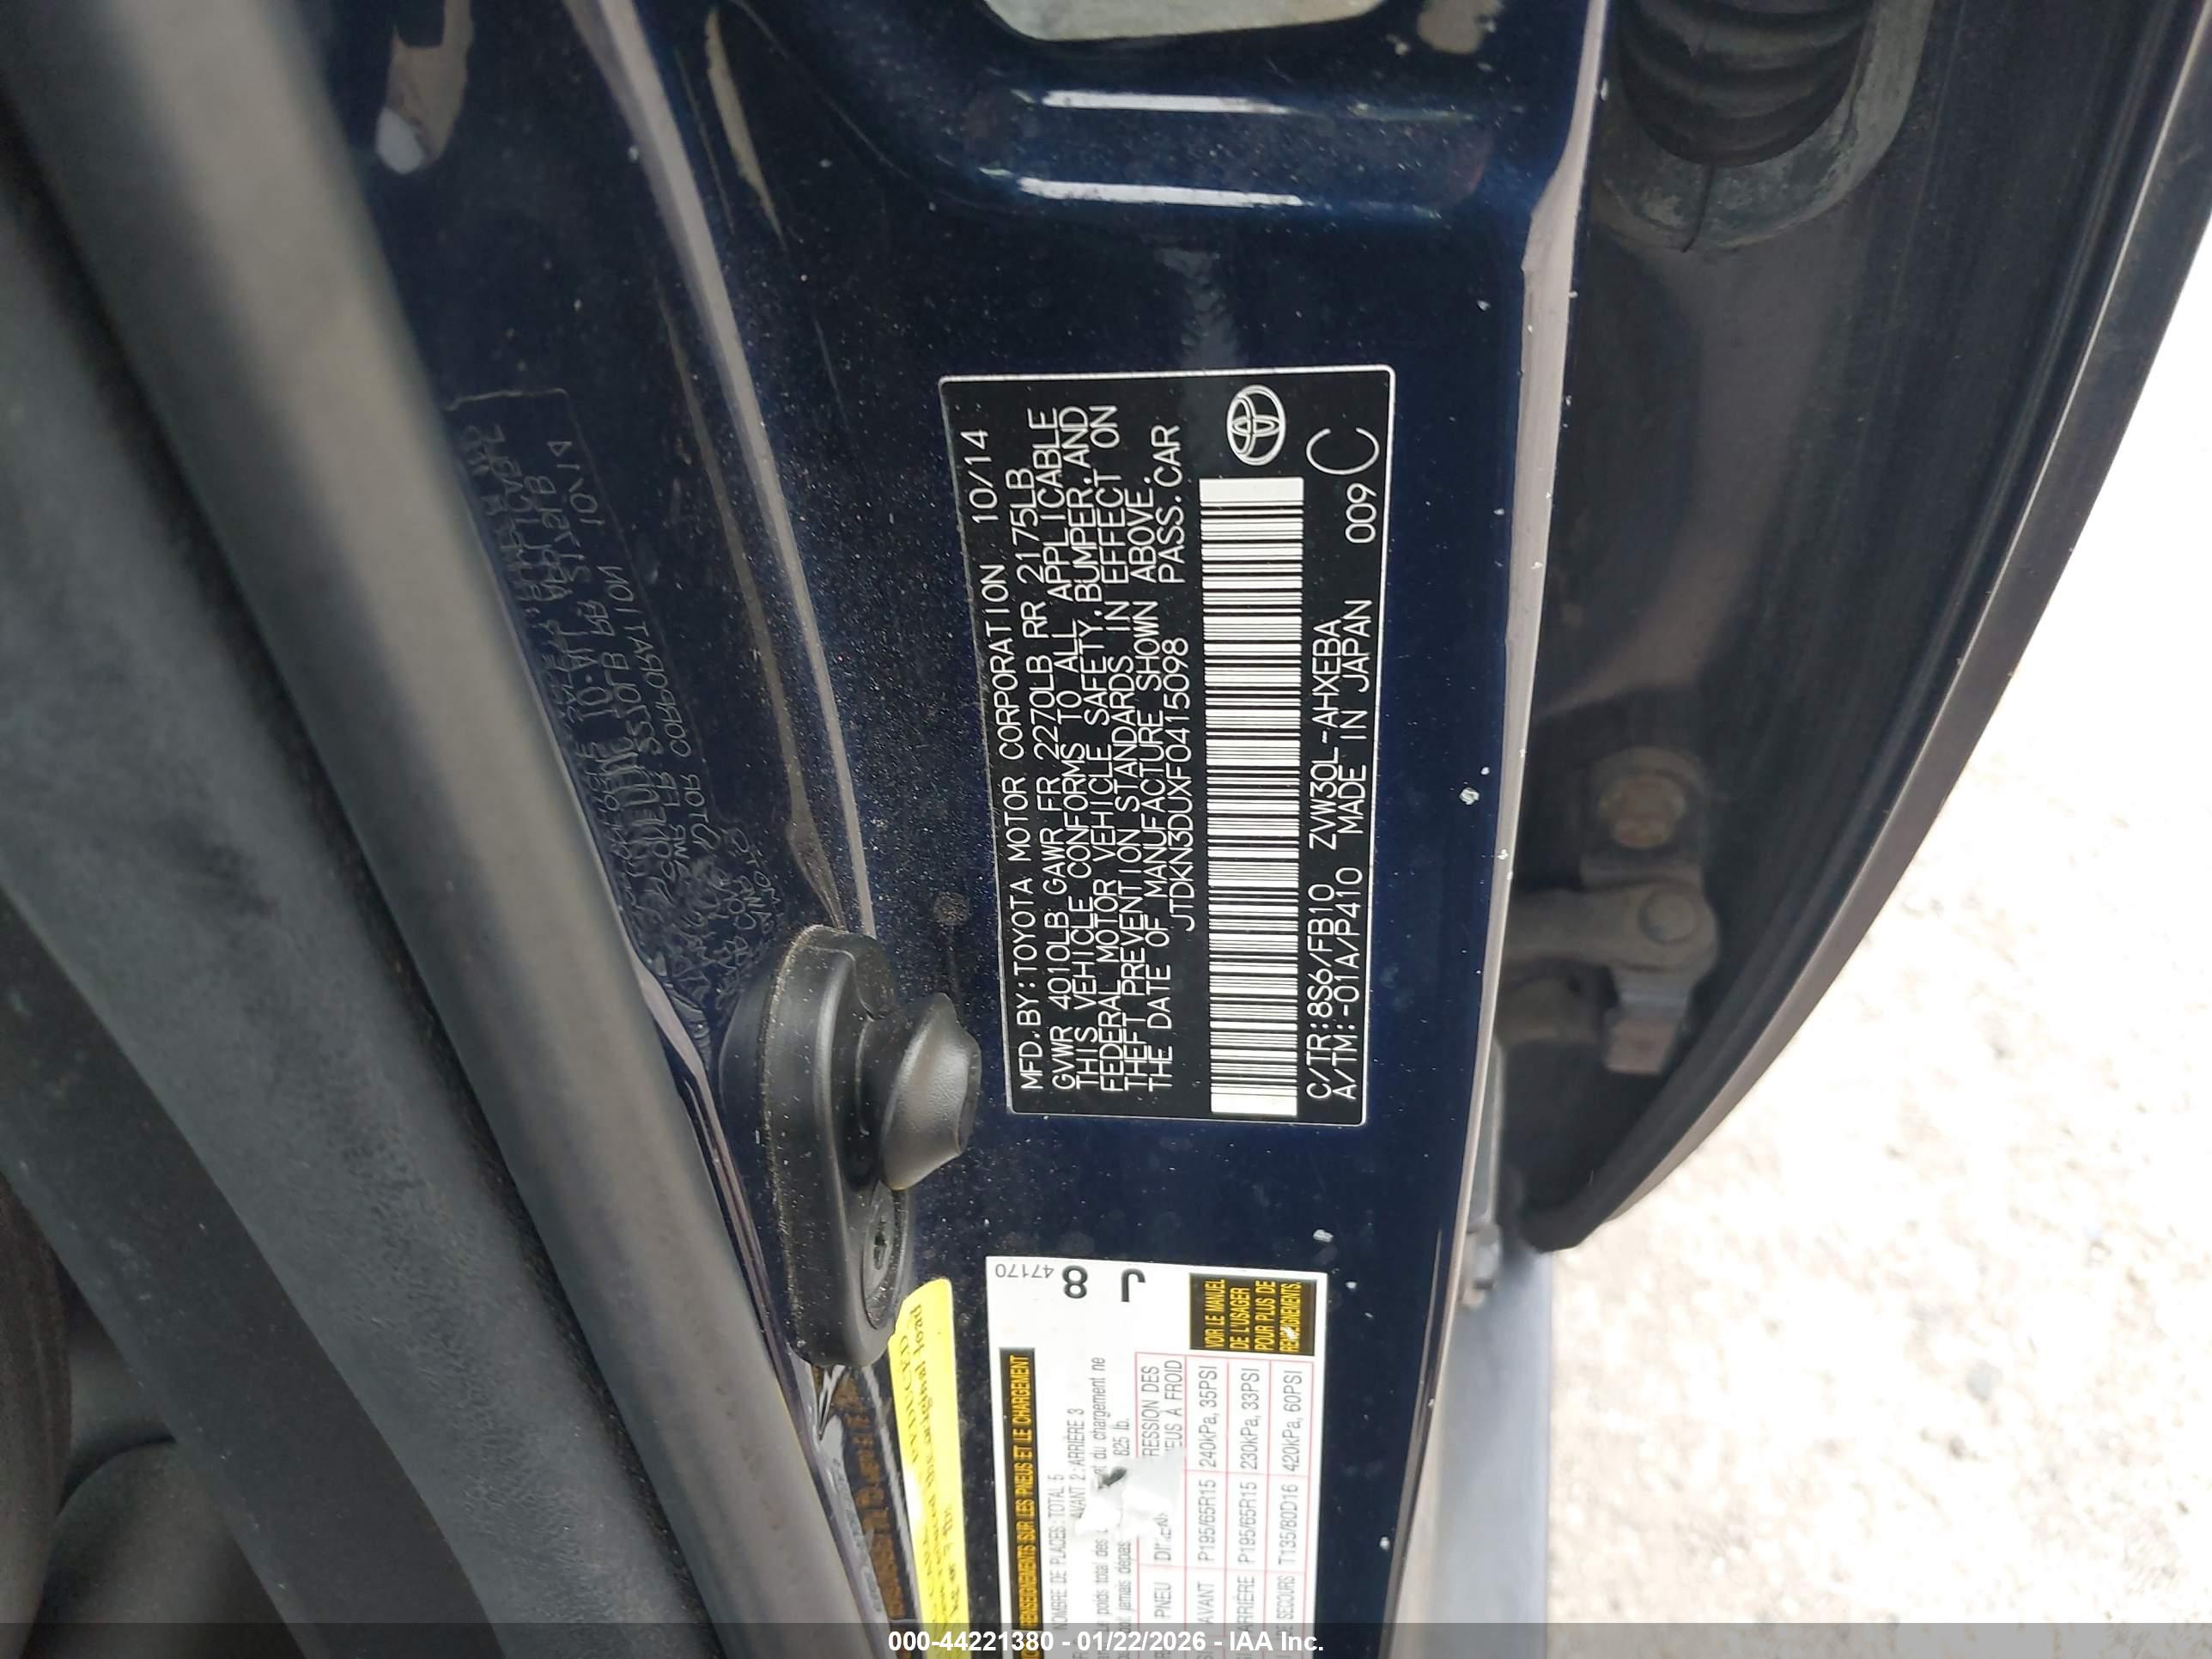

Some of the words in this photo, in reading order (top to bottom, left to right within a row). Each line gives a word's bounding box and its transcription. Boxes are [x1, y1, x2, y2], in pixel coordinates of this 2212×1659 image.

[1089, 405, 1121, 450] ON
[1305, 427, 1380, 476] C
[960, 428, 999, 523] 10/14
[1005, 467, 1044, 585] 2175LB
[1027, 408, 1074, 601] APPLICABLE
[1093, 470, 1130, 585] EFFECT
[1124, 476, 1157, 585] ABOVE.
[1345, 483, 1377, 544] 009
[1020, 600, 1050, 638] RR
[1105, 600, 1130, 632] IN
[979, 564, 1024, 760] CORPORATION
[1051, 617, 1080, 673] ALL
[1133, 600, 1162, 692] SHOWN
[1341, 599, 1373, 693] JAPAN
[1026, 654, 1060, 760] 2270LB
[1054, 690, 1084, 726] TO
[1108, 654, 1140, 813] STANDARDS
[1340, 710, 1368, 739] IN
[1309, 618, 1341, 851] ZVW30L-AHXEBA
[1036, 775, 1061, 812] FR
[1060, 743, 1092, 879] CONFORMS
[1086, 744, 1115, 863] VEHICLE
[1136, 709, 1168, 899] MANUFACTURE
[1161, 636, 1195, 933] JTDKN3DUXF0415098
[1337, 763, 1366, 835] MADE
[1002, 775, 1032, 861] MOTOR
[1039, 827, 1067, 896] GAWR
[1093, 878, 1120, 963] MOTOR
[1116, 829, 1146, 996] PREVENTION
[1145, 913, 1169, 947] OF
[1043, 911, 1073, 1011] 4010LB
[1067, 896, 1097, 1010] VEHICLE
[1146, 963, 1172, 1030] DATE
[1306, 883, 1335, 1100] C/TR:8S6/FB10
[1332, 866, 1363, 1101] A/TM:-01A/P410
[1050, 1024, 1076, 1090] GVWR
[1075, 1025, 1100, 1091] THIS
[1097, 978, 1124, 1091] FEDERAL
[1122, 1012, 1147, 1091] THEFT
[1148, 1044, 1172, 1092] THE
[995, 1263, 1054, 1279] 47170
[1061, 1264, 1088, 1299] 8
[1120, 1267, 1146, 1303] J
[1204, 1279, 1226, 1312] MANUEL
[1255, 1279, 1277, 1294] DE
[909, 1304, 926, 1355] load
[1204, 1314, 1225, 1327] LE
[1229, 1287, 1251, 1333] L'USAGER
[1255, 1297, 1276, 1322] PLUS
[1090, 1356, 1106, 1371] ne
[1204, 1328, 1225, 1348] VOIR
[1229, 1336, 1250, 1351] DE
[1254, 1325, 1275, 1351] POUR
[1009, 1354, 1032, 1425] CHARGEMENT
[1140, 1365, 1160, 1393] DES
[1164, 1358, 1183, 1401] FROID
[1198, 1365, 1218, 1407] 35PSI
[1241, 1368, 1261, 1410] 33PSI
[1283, 1370, 1303, 1413] 60PSI
[1090, 1376, 1111, 1441] chargement
[1140, 1399, 1160, 1457] RESSION
[1012, 1428, 1033, 1443] LE
[1012, 1444, 1034, 1461] ET
[1090, 1444, 1107, 1460] du
[1113, 1431, 1130, 1456] 825
[1198, 1413, 1221, 1468] 240kPa,
[1240, 1415, 1262, 1470] 230kPa,
[1282, 1418, 1304, 1473] 420kPa,
[1013, 1462, 1035, 1495] PNEUS
[1015, 1498, 1036, 1518] LES
[1016, 1521, 1036, 1542] SUR
[1197, 1478, 1217, 1562] P195/65R15
[1237, 1480, 1258, 1564] P195/65R15
[1278, 1483, 1299, 1565] T135/80D16
[1092, 1538, 1109, 1557] des
[1093, 1563, 1109, 1583] total
[1049, 1569, 1068, 1584] DE
[1154, 1582, 1172, 1619] PNEU
[1197, 1580, 1216, 1626] AVANT
[1275, 1575, 1296, 1620] SECOURS
